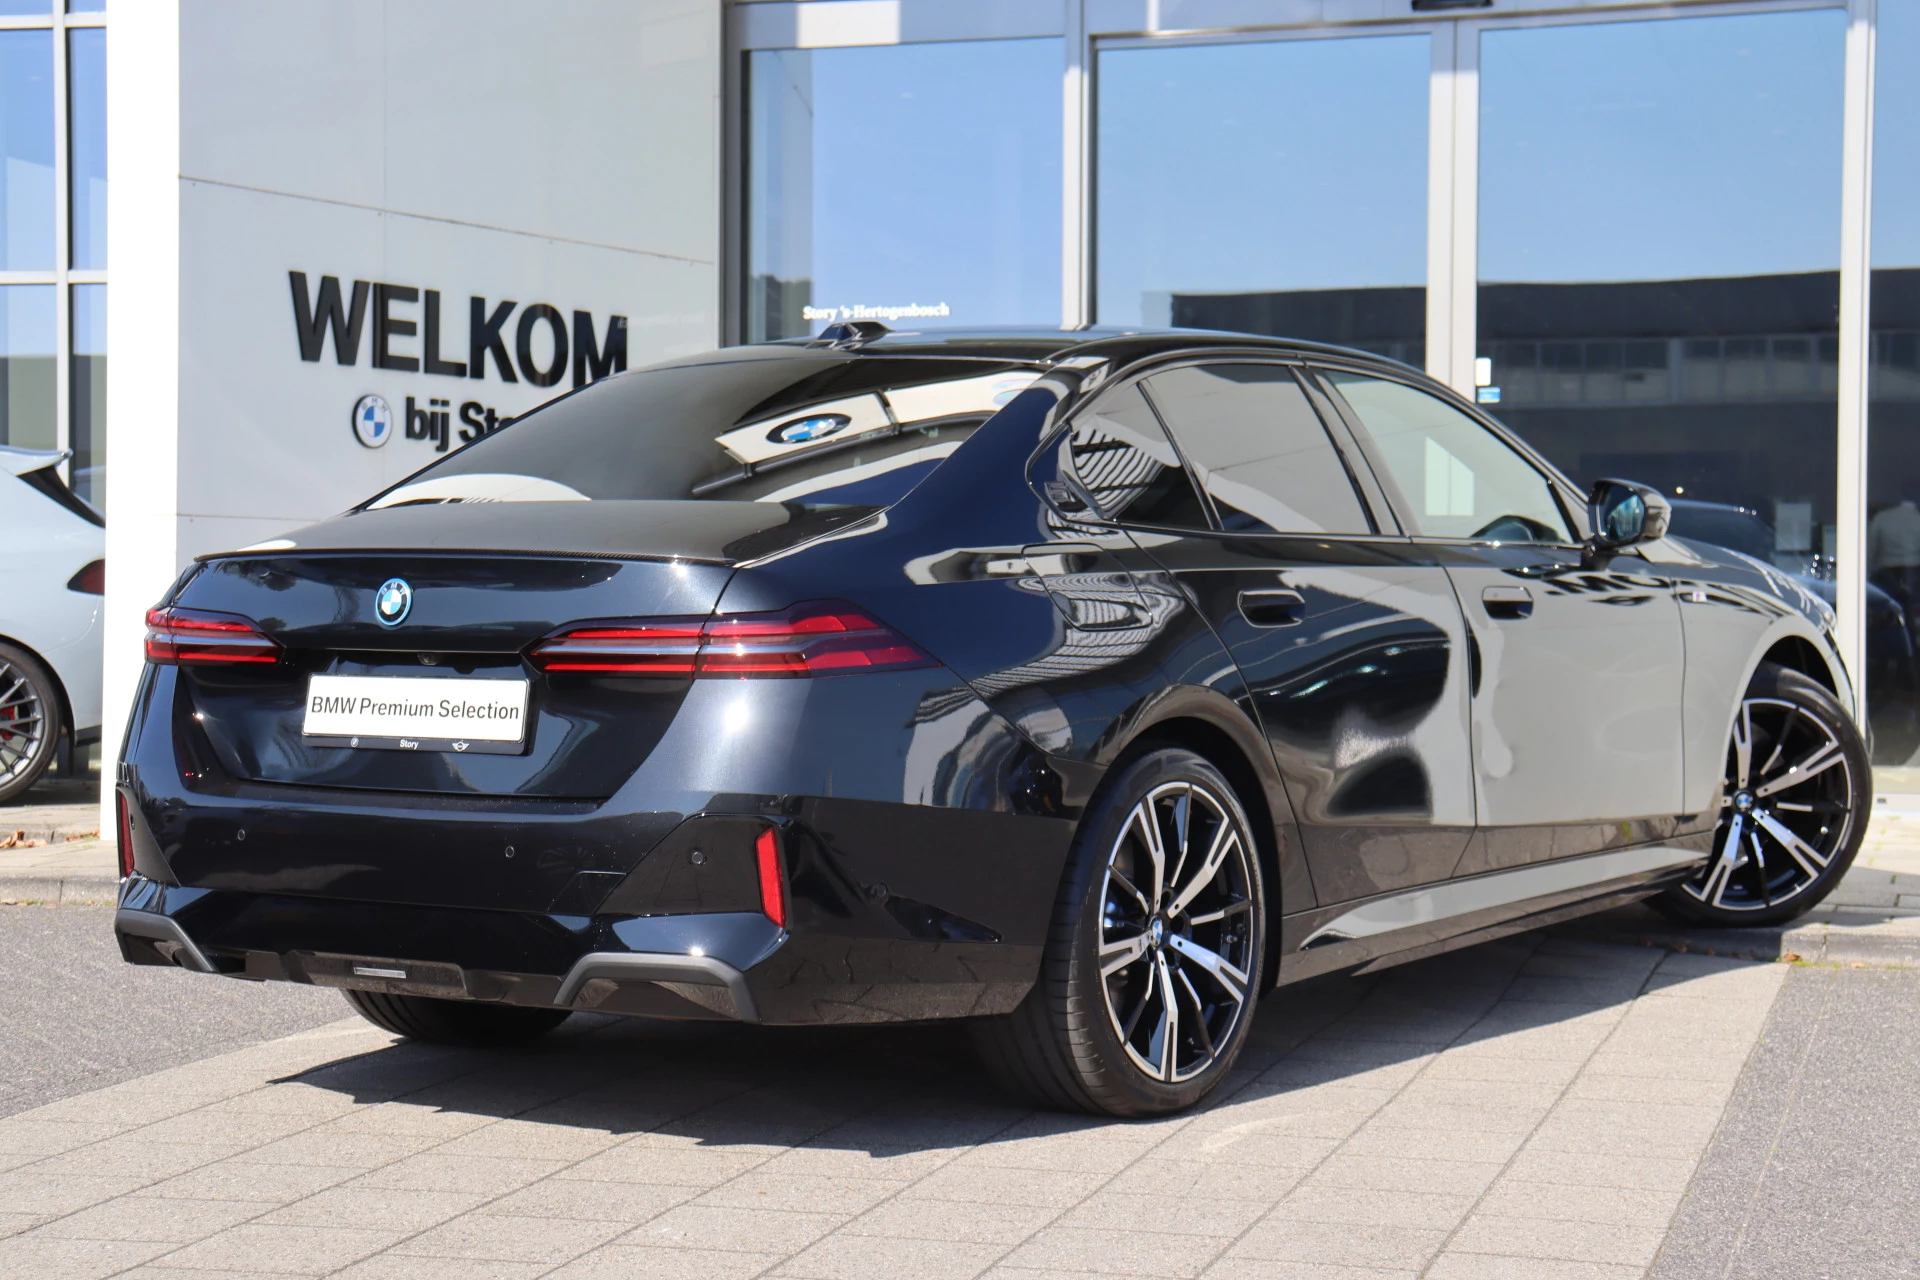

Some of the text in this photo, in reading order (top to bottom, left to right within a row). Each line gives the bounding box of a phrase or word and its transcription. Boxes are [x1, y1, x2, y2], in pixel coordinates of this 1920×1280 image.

[803, 305, 837, 322] Story
[289, 271, 628, 388] WELKOM
[405, 396, 516, 452] bij St
[311, 696, 519, 719] BMW Premium Selection
[399, 738, 419, 750] Story
